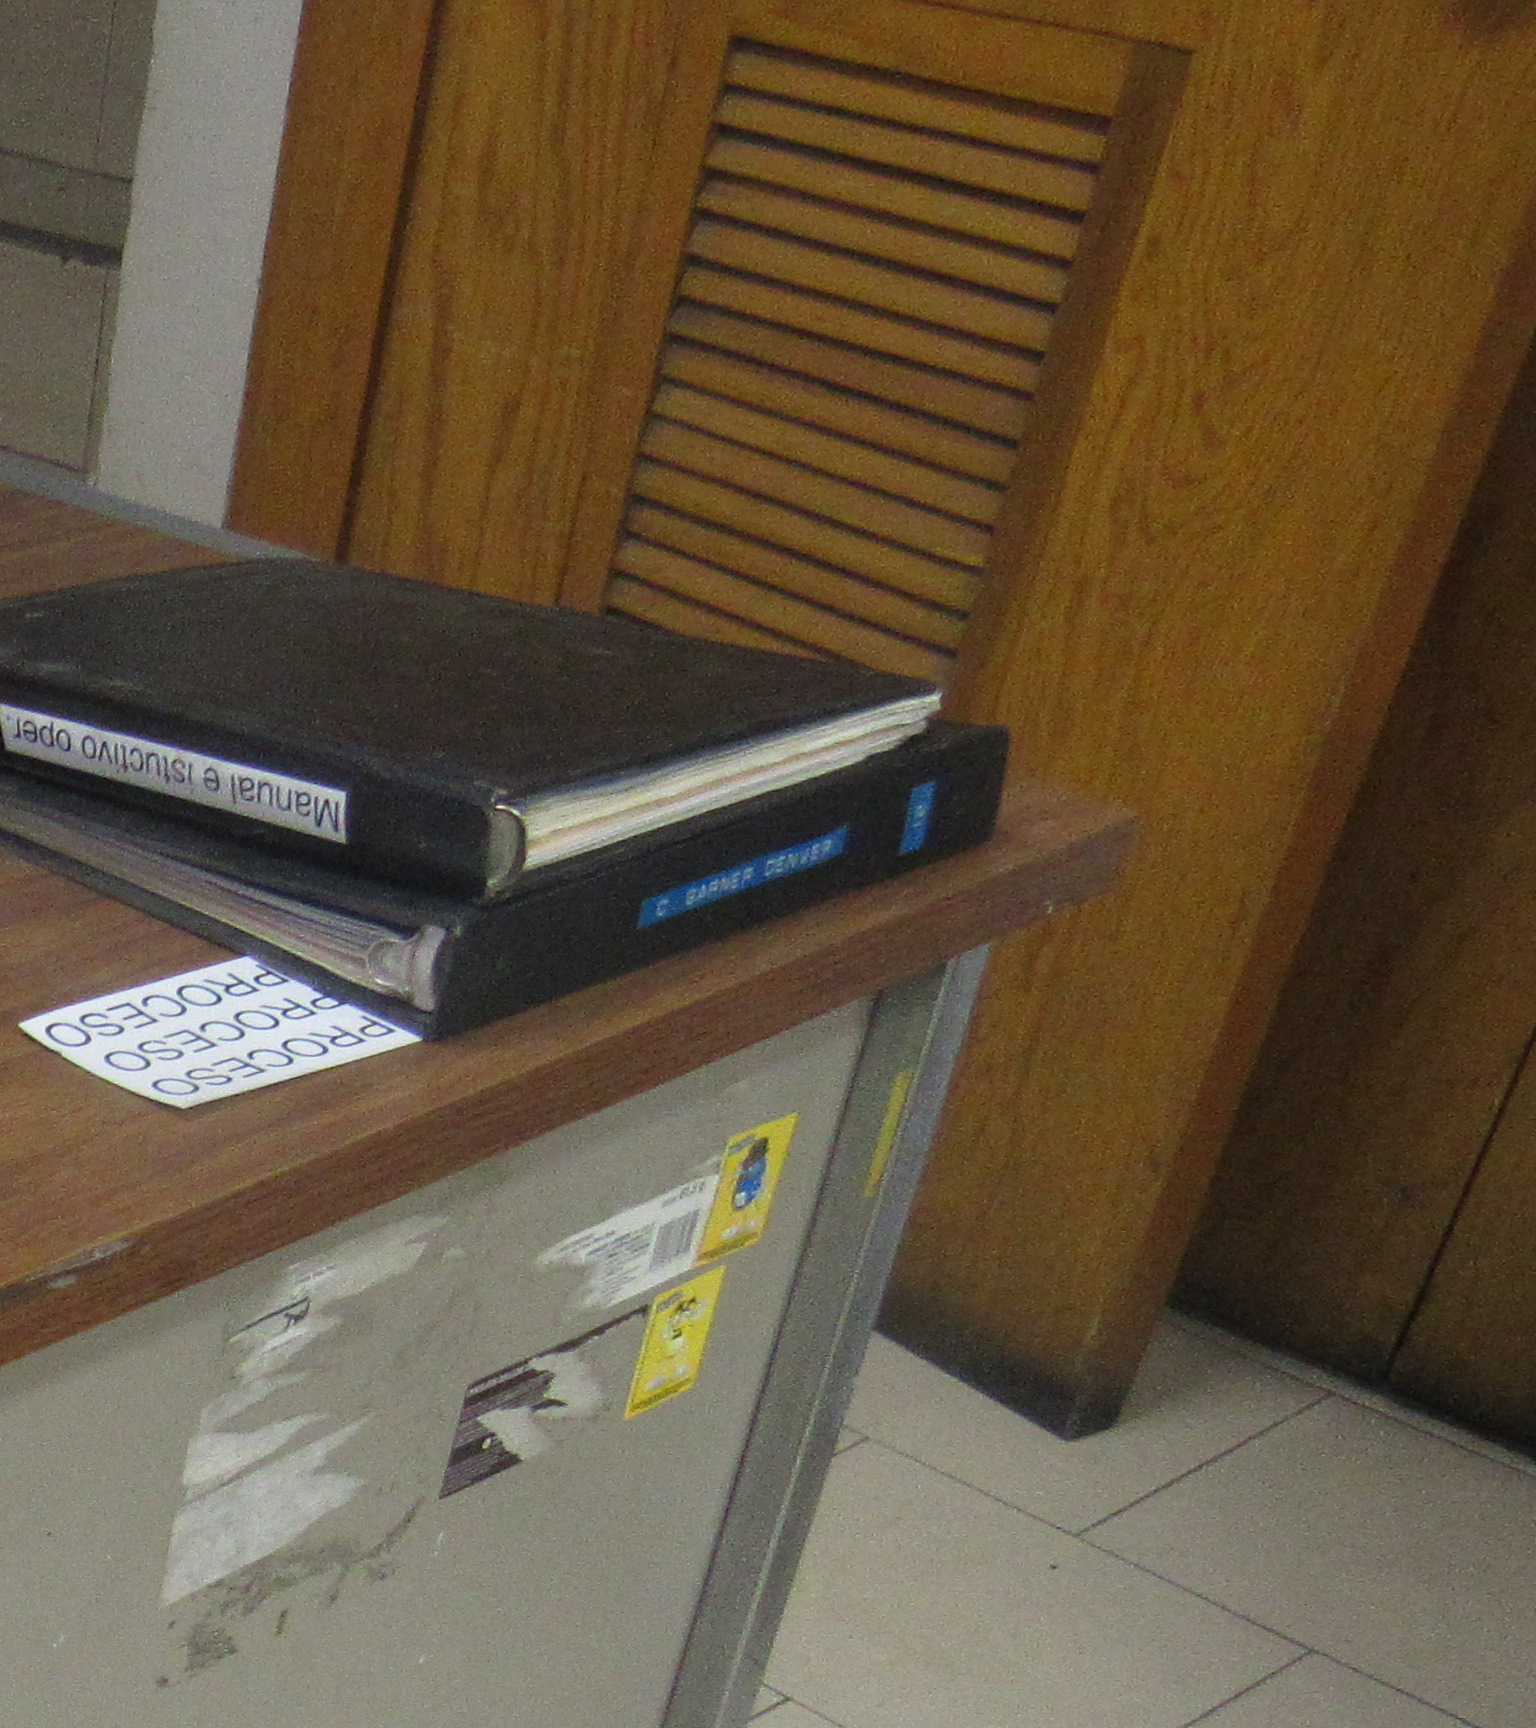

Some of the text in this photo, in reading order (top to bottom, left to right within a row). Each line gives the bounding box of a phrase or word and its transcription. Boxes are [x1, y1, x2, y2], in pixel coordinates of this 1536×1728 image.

[5, 714, 72, 753] oper.
[203, 766, 220, 792] e
[231, 773, 340, 833] Manual
[44, 963, 290, 1048] PROCESO
[103, 995, 348, 1072] PROCESO
[151, 1015, 397, 1096] PROCESO
